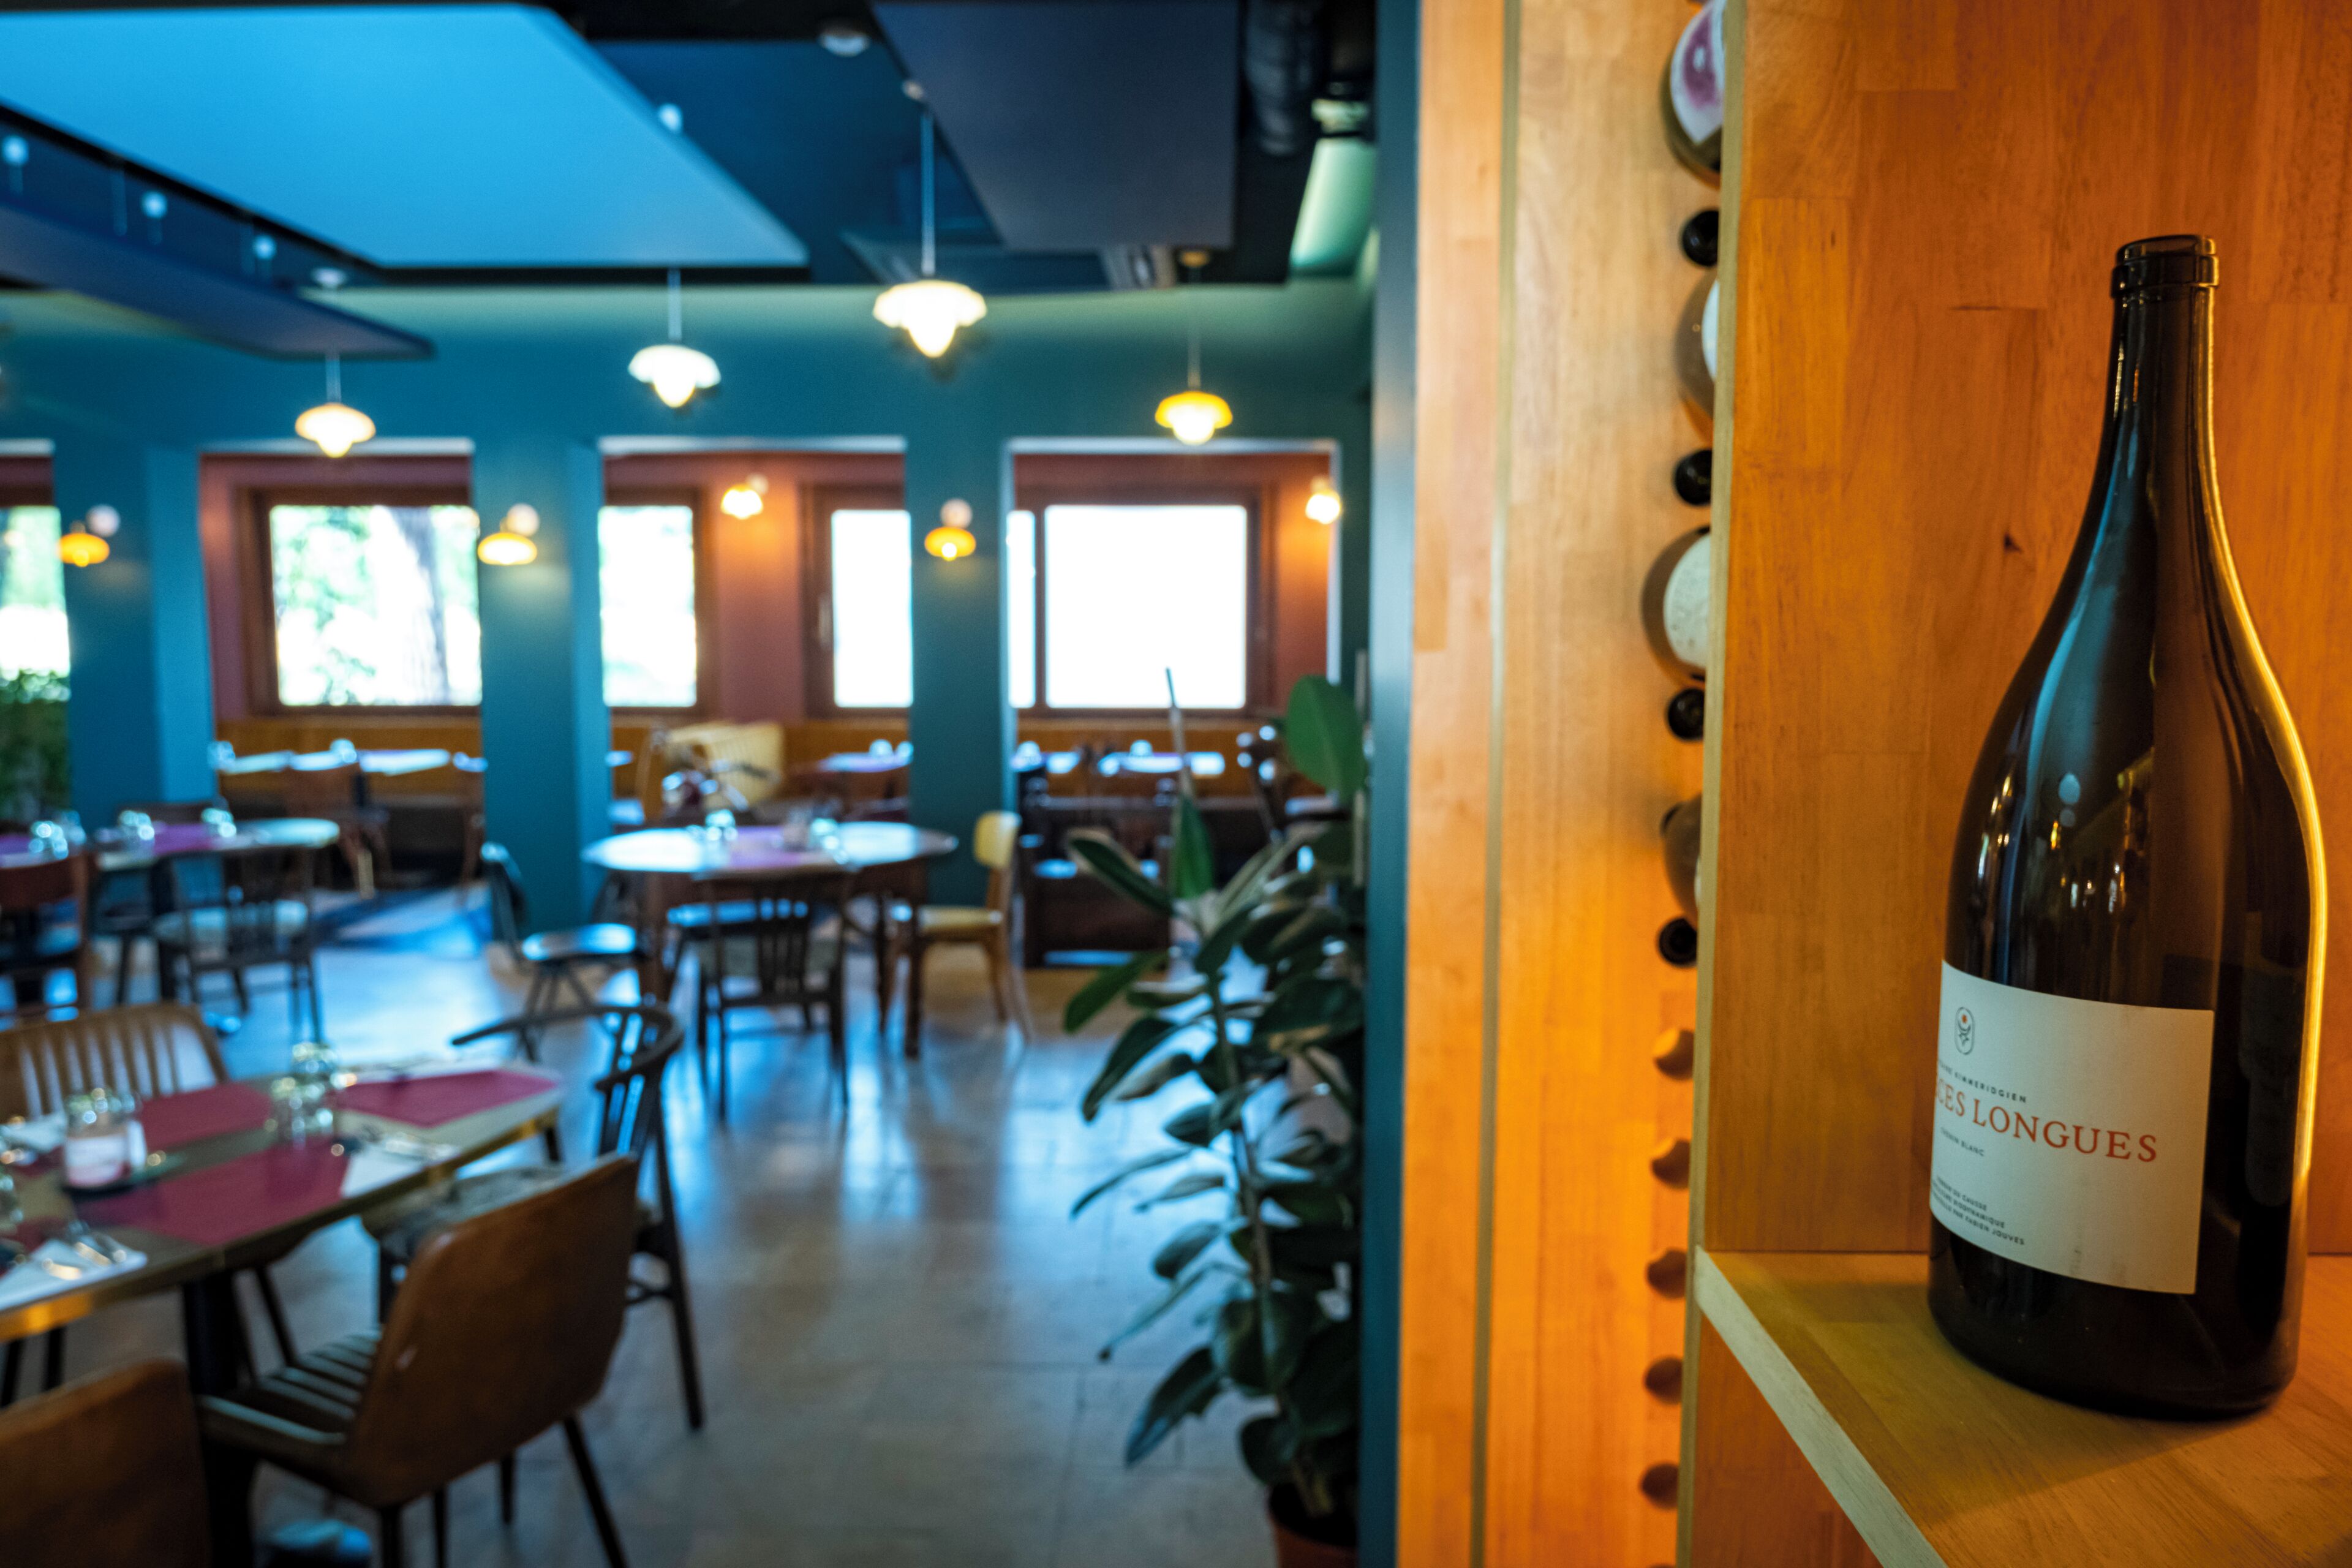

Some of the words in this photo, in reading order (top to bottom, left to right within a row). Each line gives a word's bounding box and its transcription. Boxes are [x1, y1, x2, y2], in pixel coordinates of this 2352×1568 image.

[1937, 1079, 1966, 1116] CES
[1973, 1099, 2157, 1162] LONGUES
[1992, 1229, 2024, 1245] JOUVES
